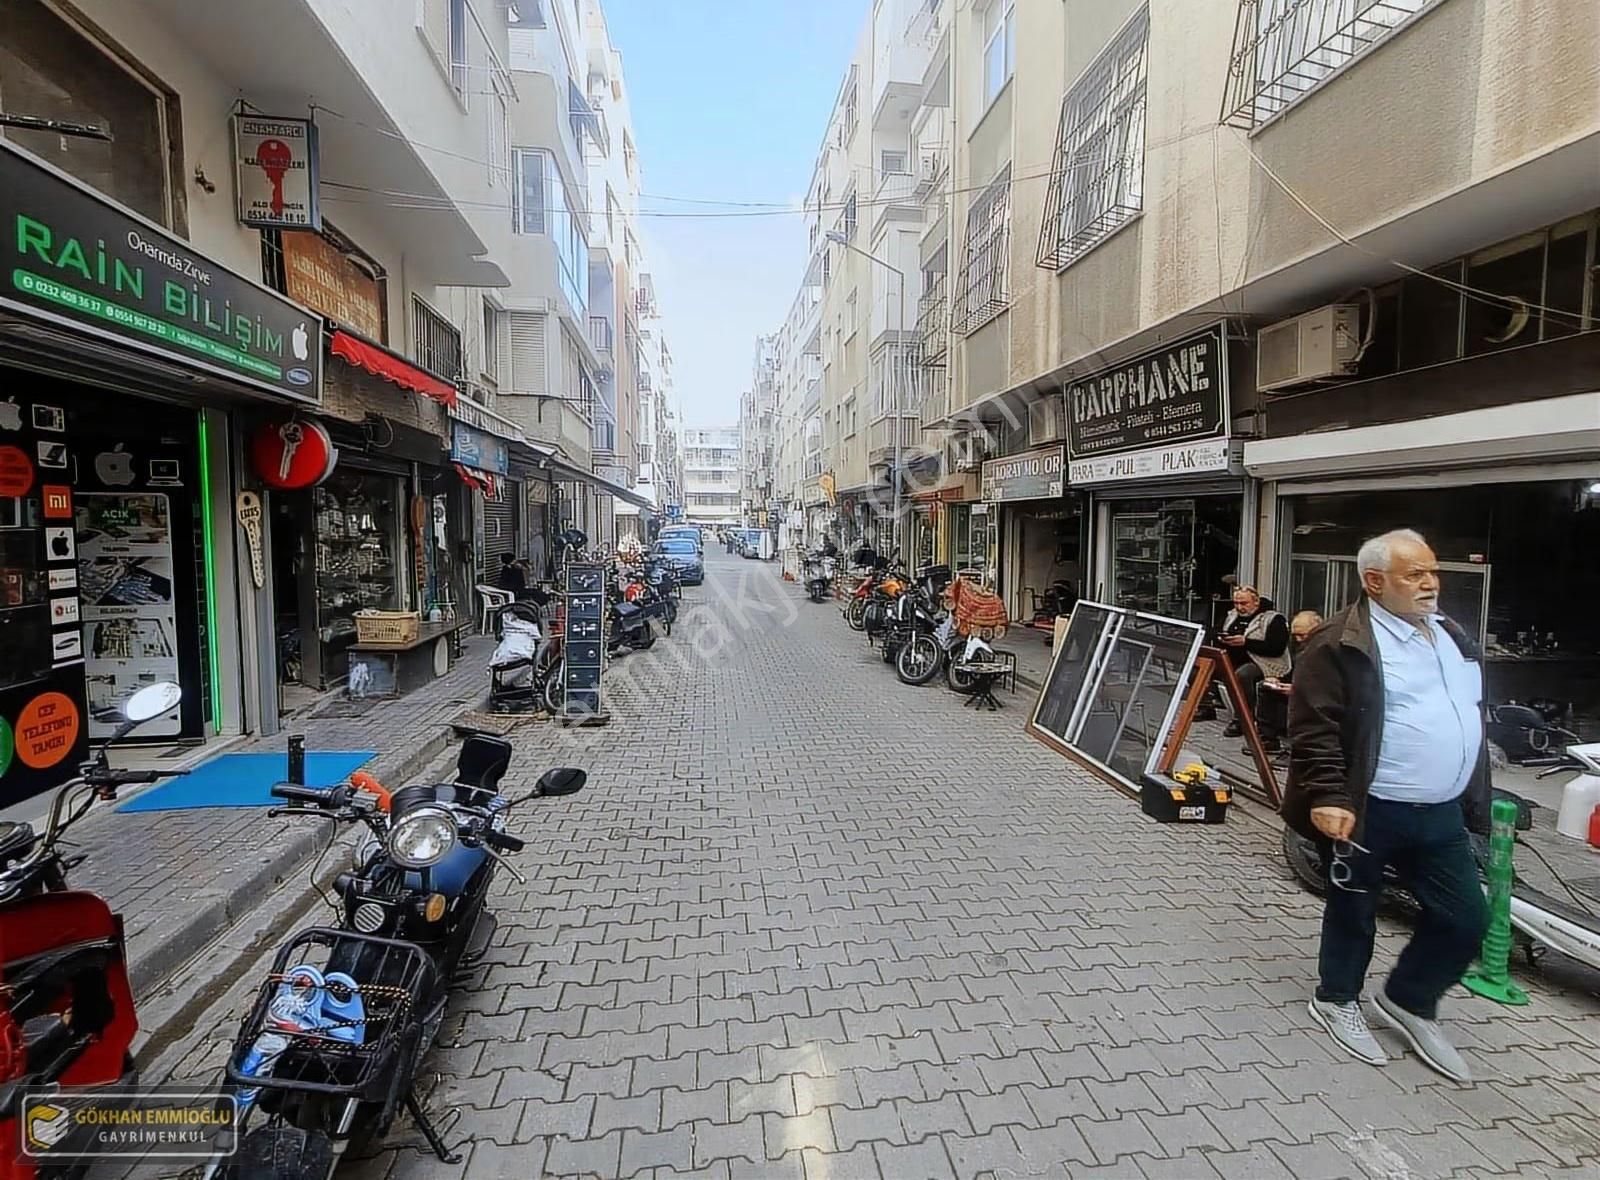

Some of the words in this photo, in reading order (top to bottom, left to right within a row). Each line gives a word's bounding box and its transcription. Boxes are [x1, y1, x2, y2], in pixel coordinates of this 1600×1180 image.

[35, 280, 59, 298] 0232
[164, 281, 283, 358] BİLİŞİM
[1073, 343, 1210, 424] DARPHANE
[1116, 457, 1136, 476] PUL
[1161, 449, 1196, 471] PLAK
